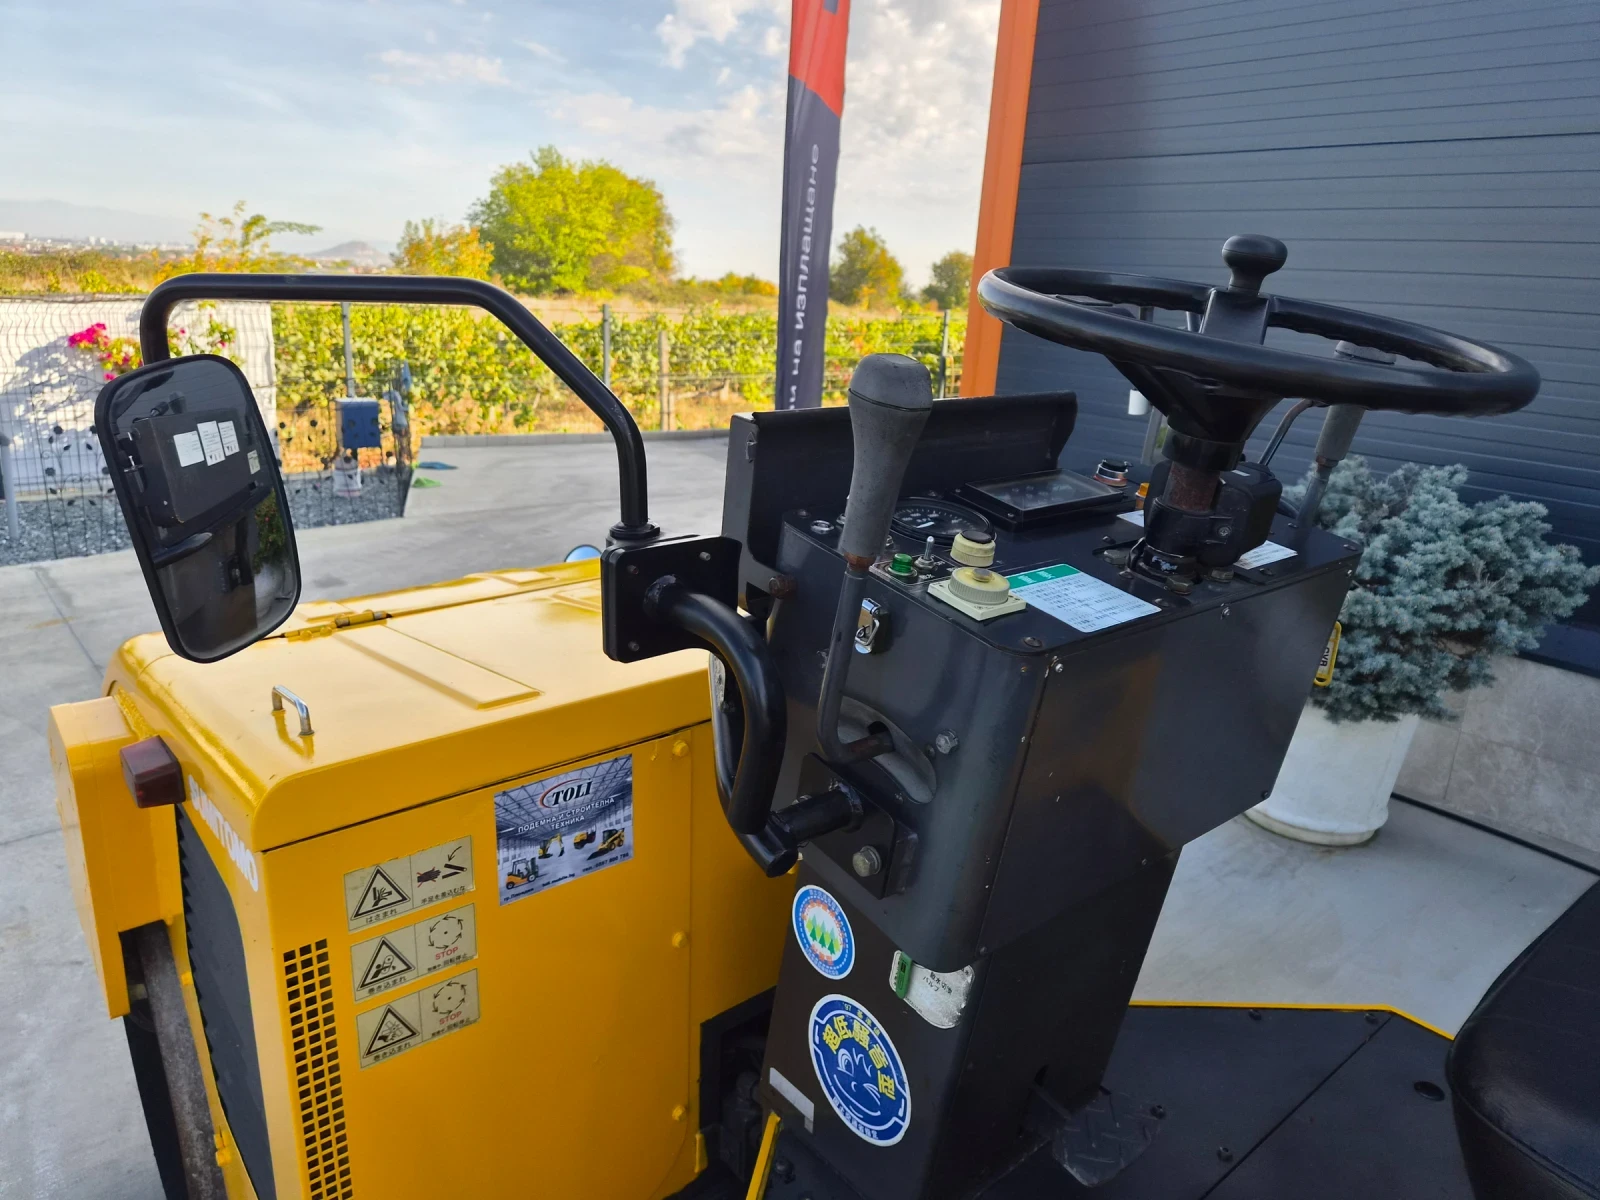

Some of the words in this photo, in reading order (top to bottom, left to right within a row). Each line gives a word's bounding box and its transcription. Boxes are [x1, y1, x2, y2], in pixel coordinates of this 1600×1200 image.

[795, 143, 819, 330] изплащане
[792, 340, 803, 376] на
[518, 816, 557, 833] ПОДЕМНА
[566, 798, 615, 817] СТРОИТЕЛНА
[551, 815, 585, 830] ТЕХНИКА
[435, 946, 459, 960] STOP
[439, 1011, 462, 1025] STOP
[822, 1015, 896, 1100] 超低騒音型
